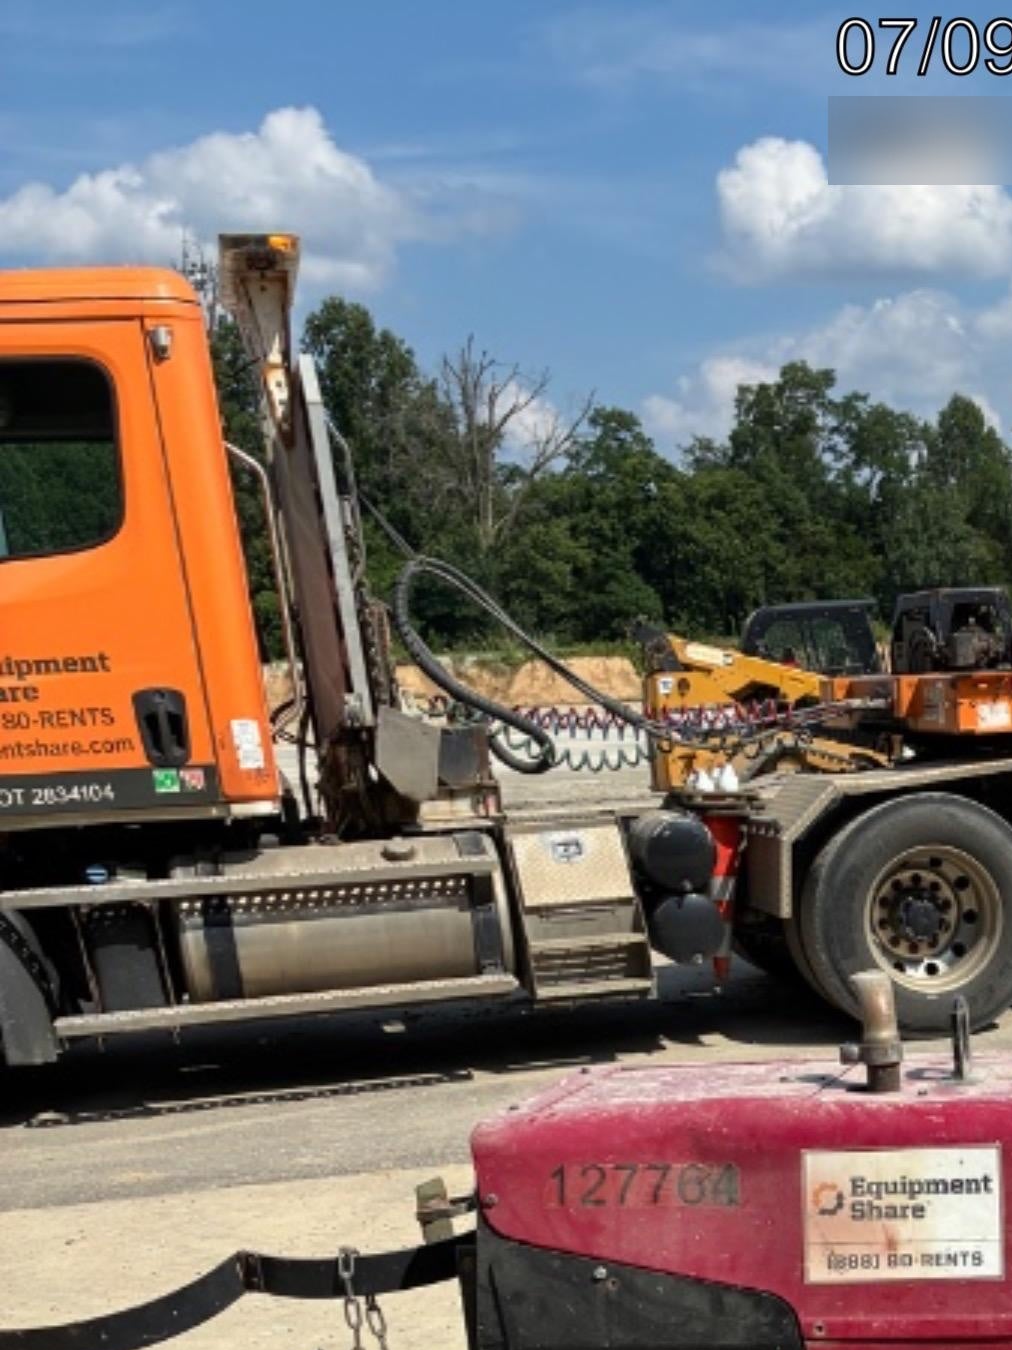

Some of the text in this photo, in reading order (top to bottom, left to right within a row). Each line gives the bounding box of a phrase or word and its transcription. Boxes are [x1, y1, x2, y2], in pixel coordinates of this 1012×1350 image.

[0, 652, 111, 680] ipment
[549, 1163, 740, 1207] 127764
[850, 1174, 993, 1201] Equipment
[851, 1201, 927, 1222] Share
